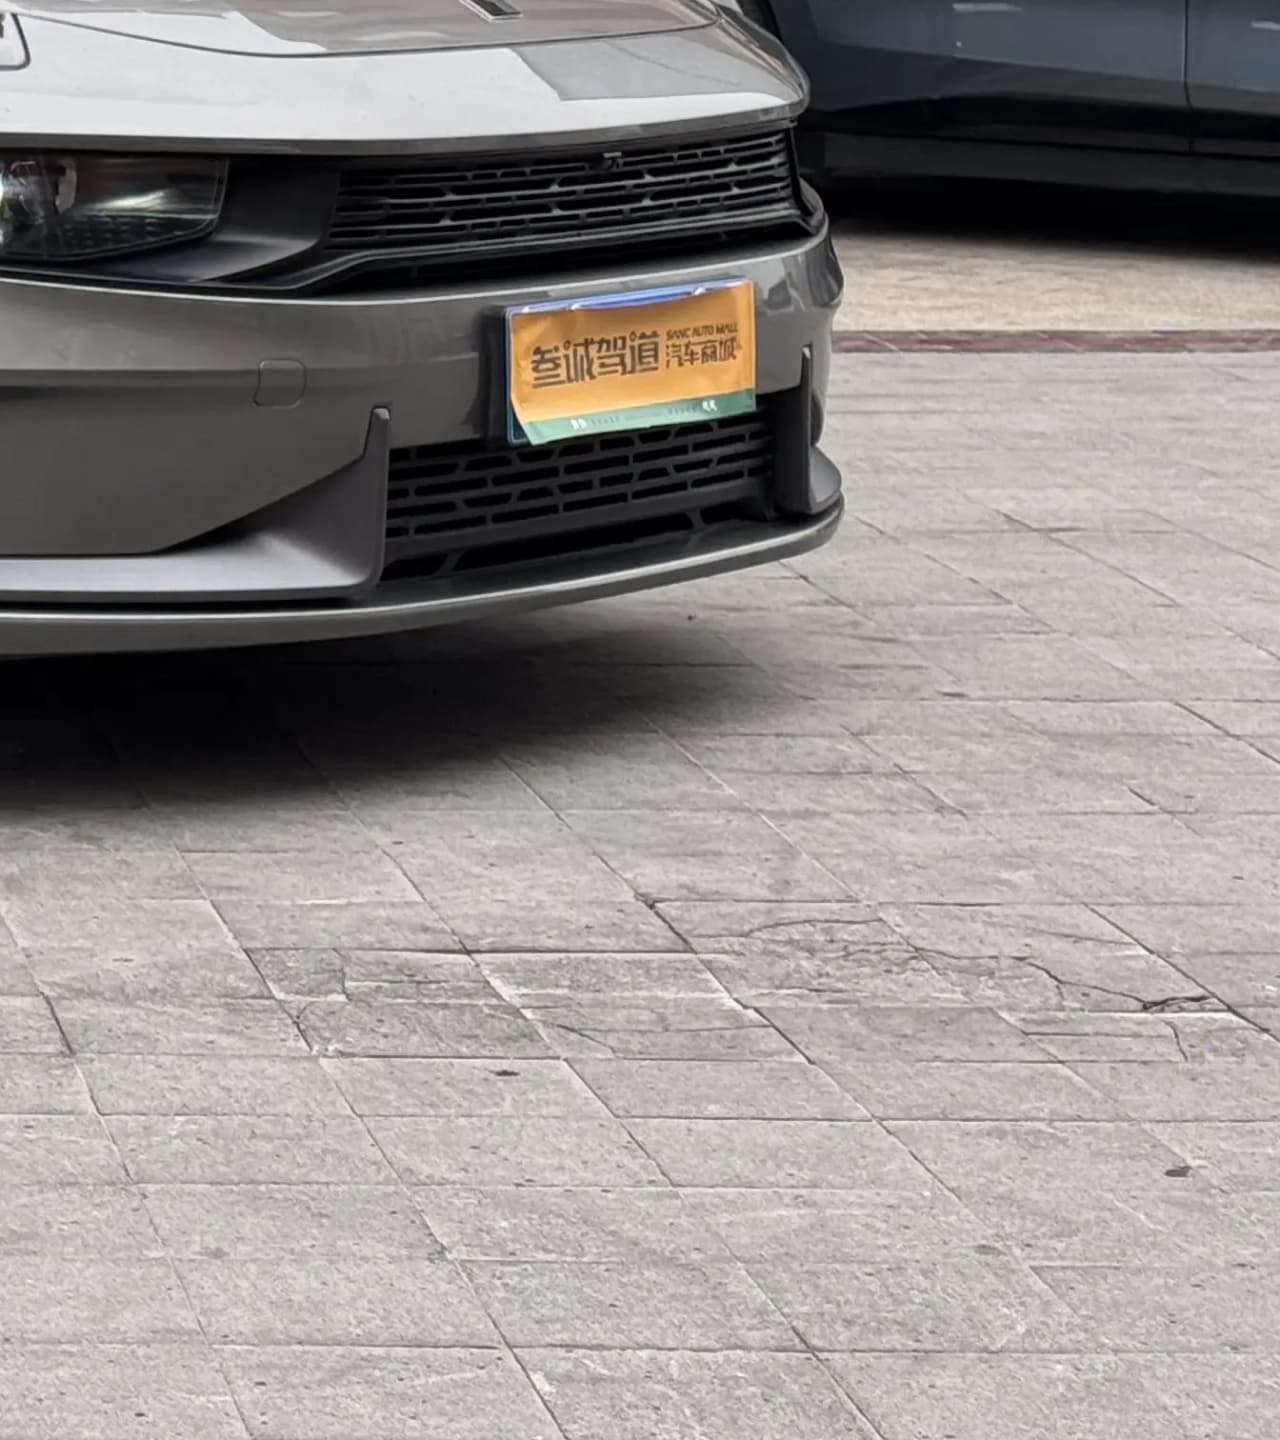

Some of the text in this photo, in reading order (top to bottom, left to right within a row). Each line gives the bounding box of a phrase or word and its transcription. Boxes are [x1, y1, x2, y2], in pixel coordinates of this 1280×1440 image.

[665, 321, 739, 342] SANC AUTO MALL
[531, 330, 738, 389] 叁诚驾道 汽车商城
